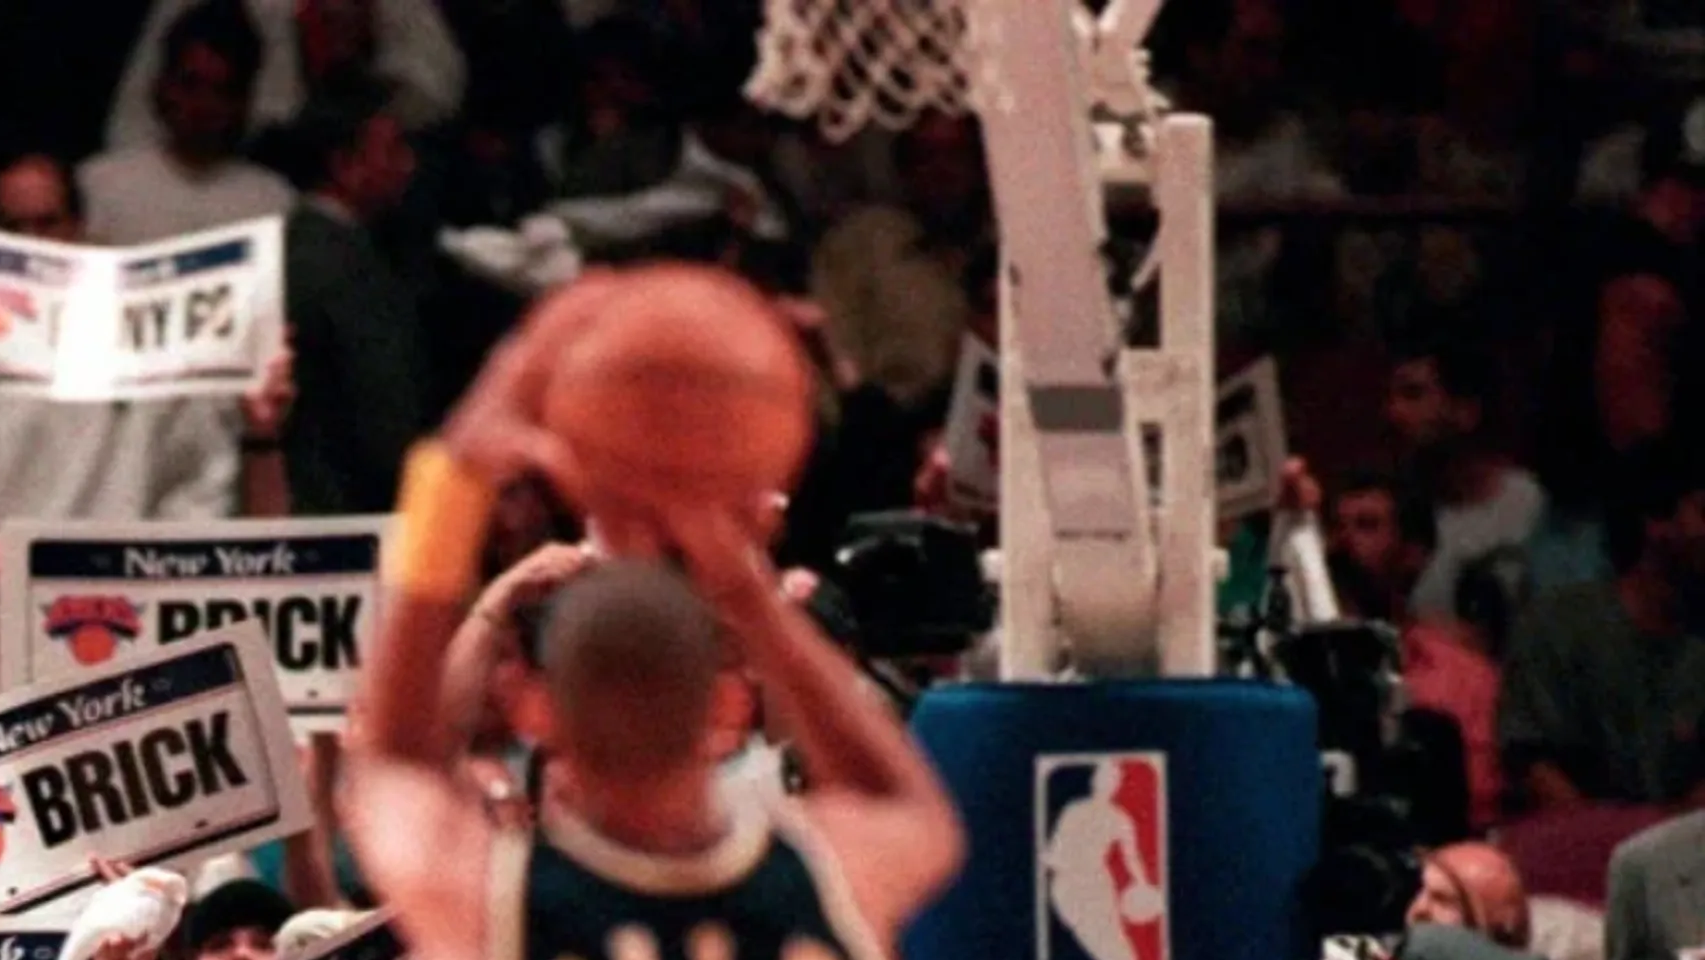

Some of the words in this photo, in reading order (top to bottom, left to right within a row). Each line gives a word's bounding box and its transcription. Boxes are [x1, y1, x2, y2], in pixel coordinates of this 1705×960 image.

[124, 547, 207, 576] New
[213, 544, 297, 573] York
[58, 676, 147, 725] York
[21, 712, 247, 848] BRICK
